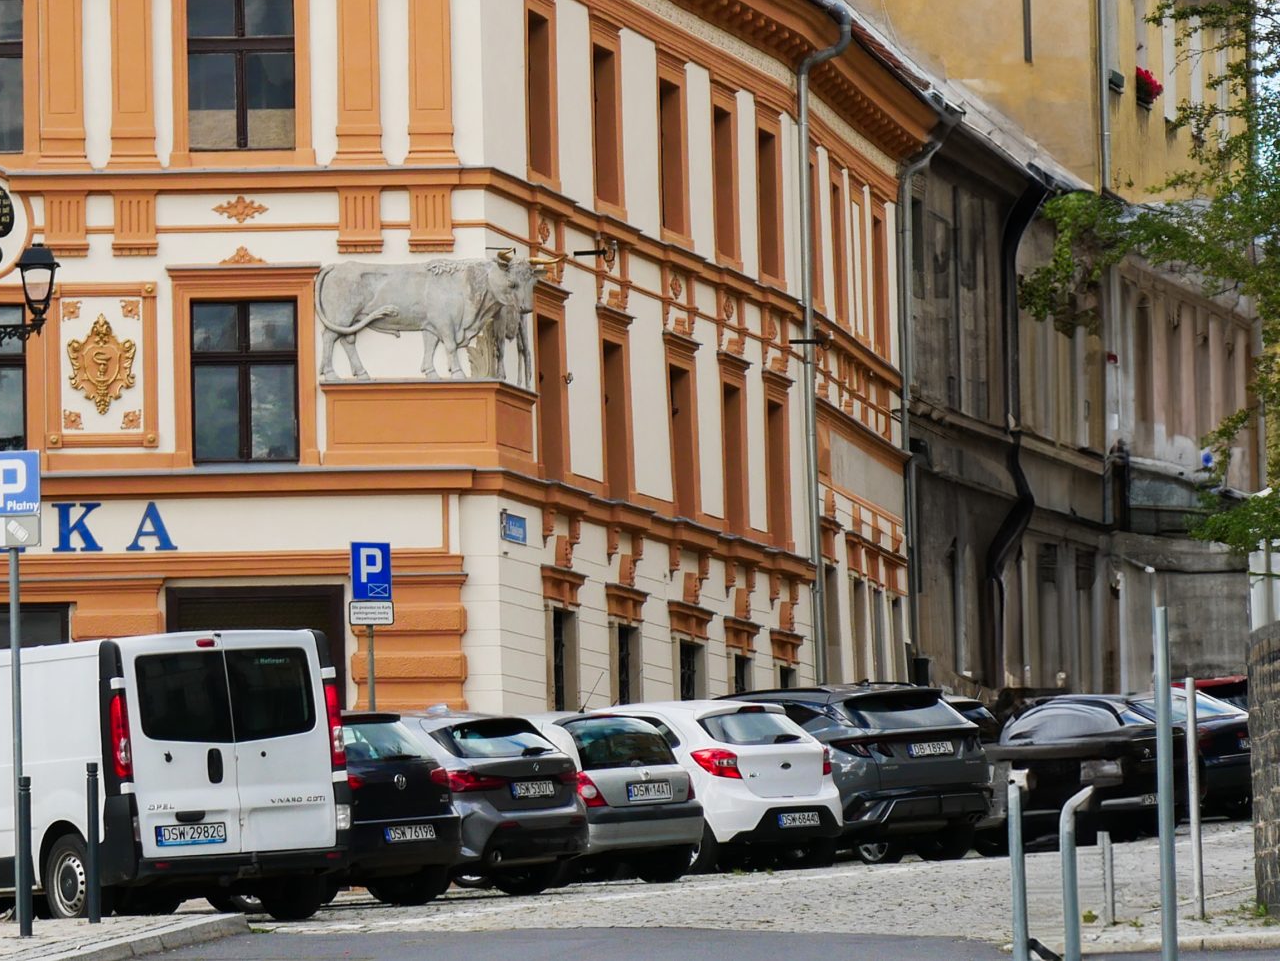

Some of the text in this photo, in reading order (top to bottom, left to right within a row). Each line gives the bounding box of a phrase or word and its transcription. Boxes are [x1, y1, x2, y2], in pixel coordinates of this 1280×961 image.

[360, 547, 383, 583] P
[632, 785, 649, 796] DSW
[163, 824, 224, 841] DSW 2982C
[389, 825, 434, 840] DSW 76198
